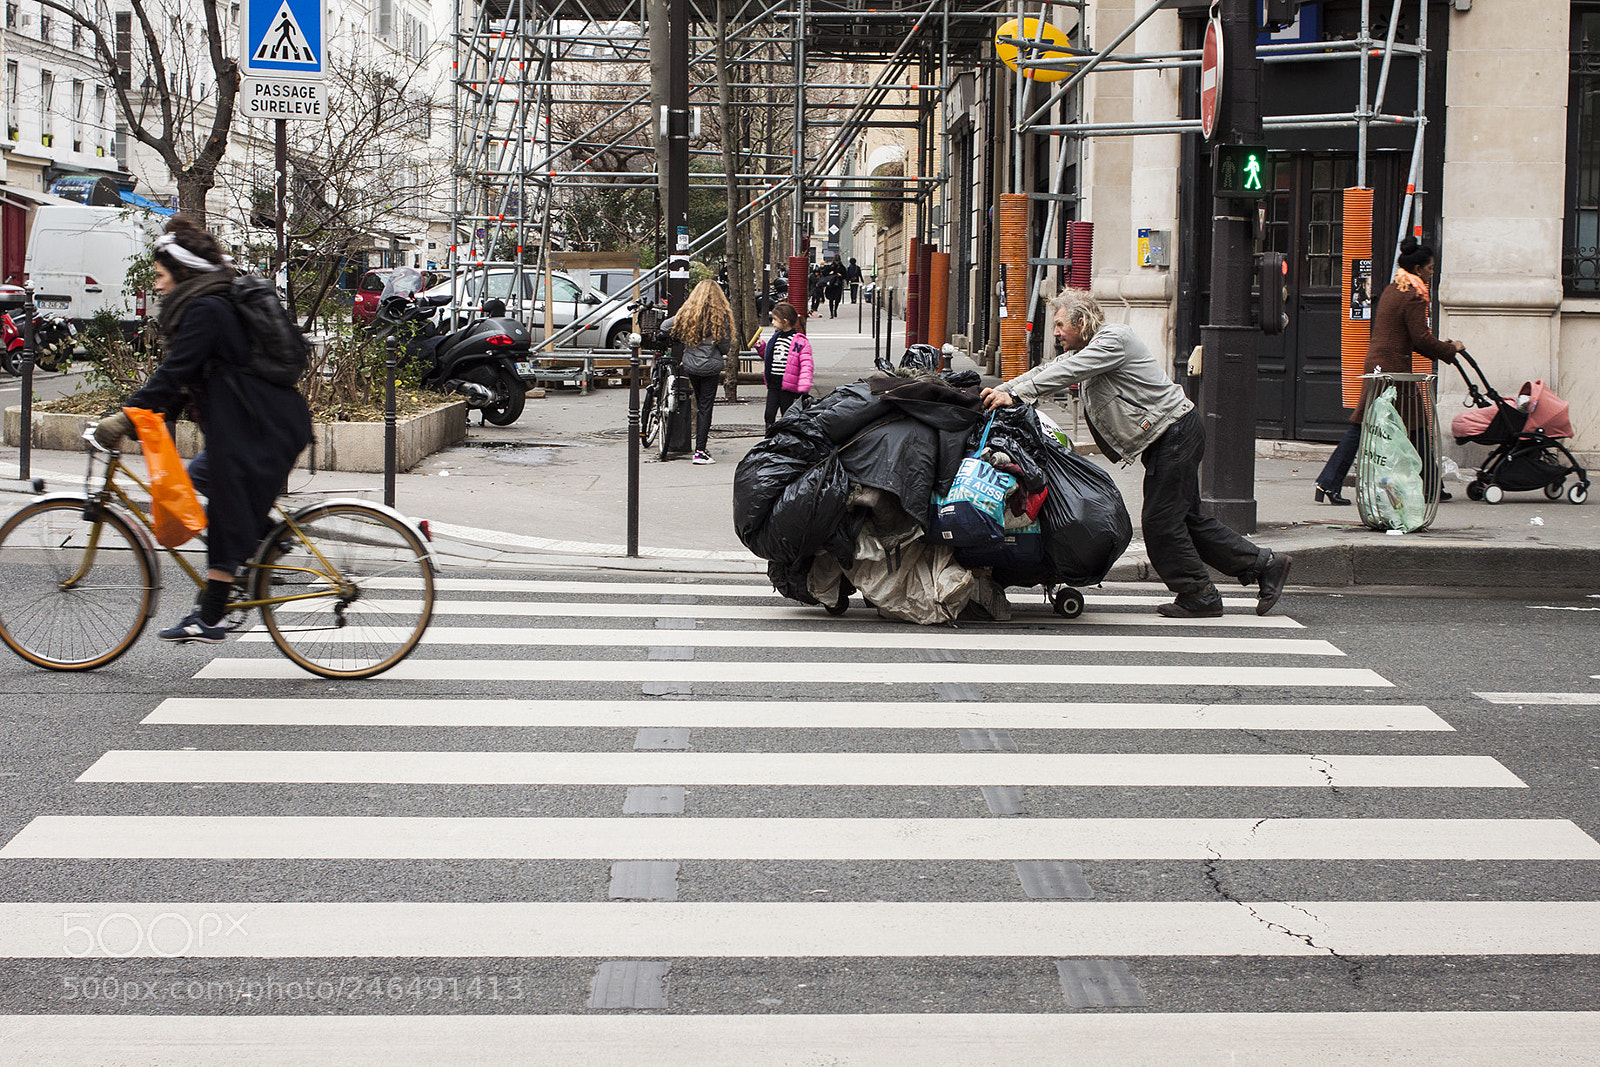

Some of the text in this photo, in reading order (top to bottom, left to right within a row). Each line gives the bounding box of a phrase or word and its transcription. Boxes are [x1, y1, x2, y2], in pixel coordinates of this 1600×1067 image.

[255, 83, 316, 99] PASSAGE
[250, 99, 321, 115] SURELEVÉ
[792, 342, 803, 353] N
[977, 463, 1010, 489] VIE
[972, 480, 1005, 502] AUSSI
